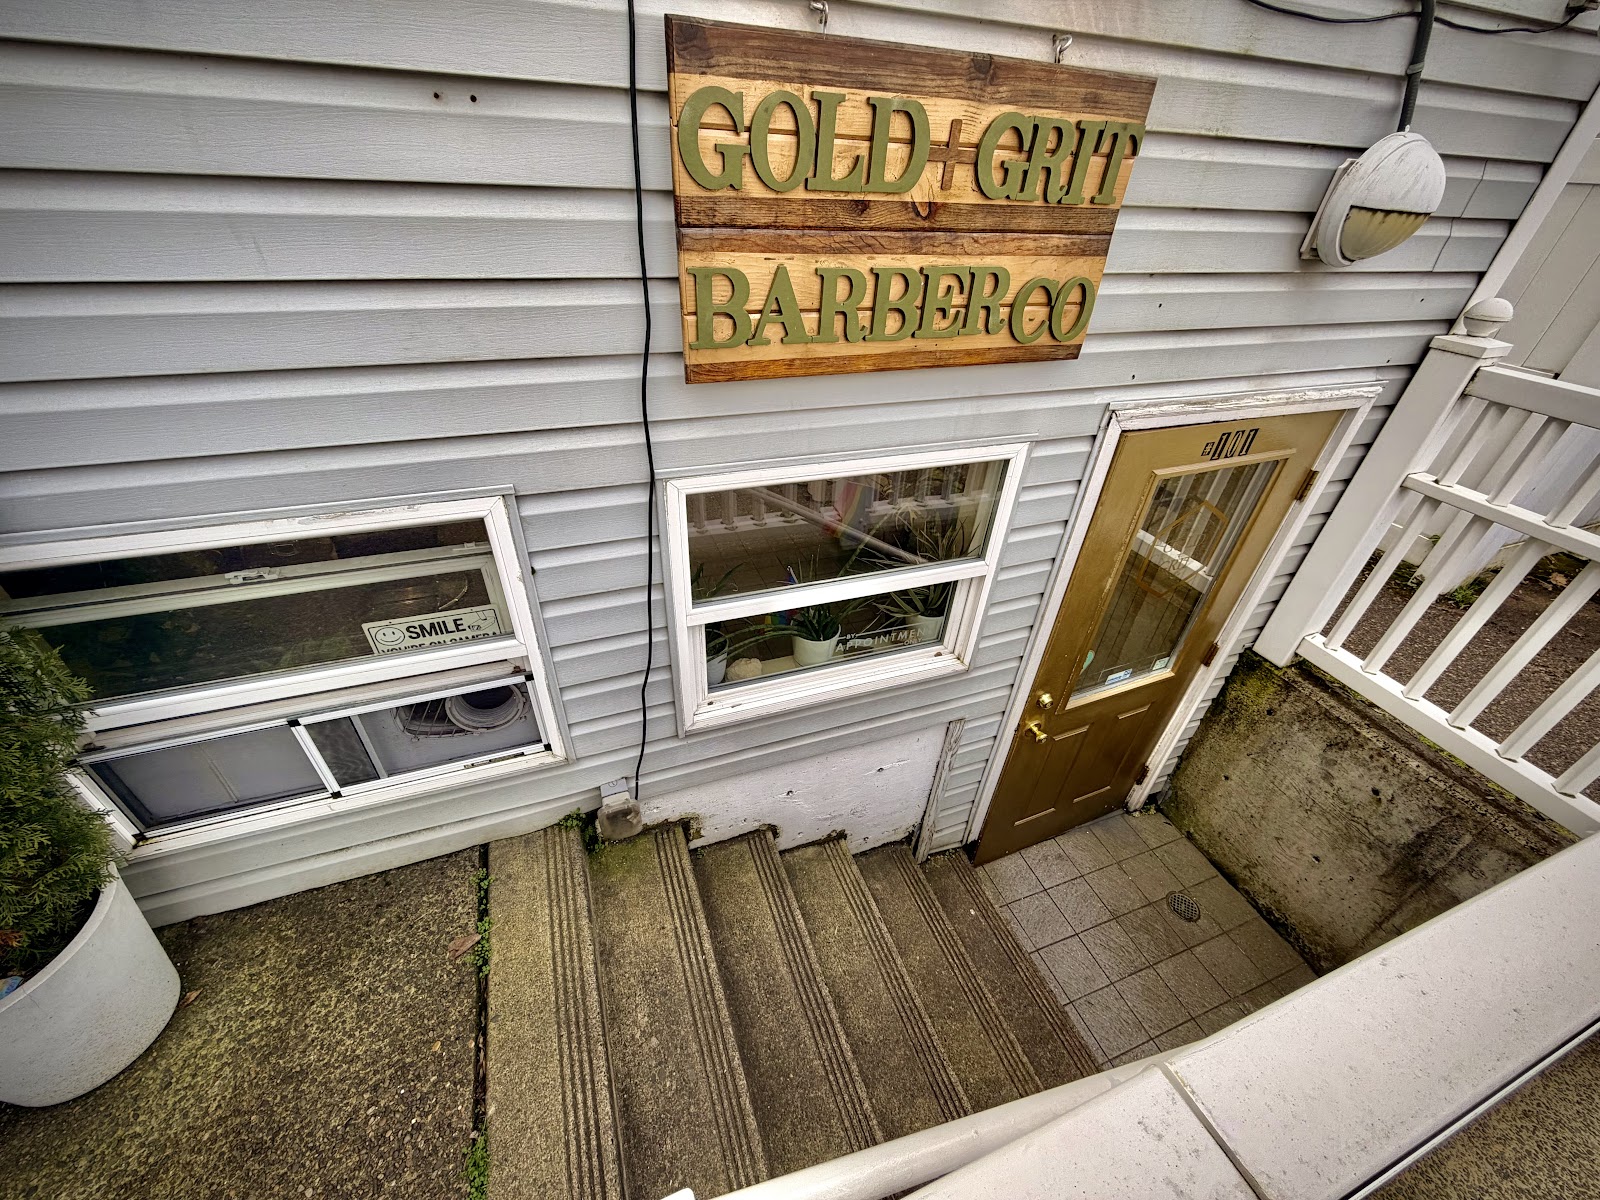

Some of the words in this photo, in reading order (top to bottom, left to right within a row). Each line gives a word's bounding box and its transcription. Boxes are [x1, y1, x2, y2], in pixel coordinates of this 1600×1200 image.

[678, 85, 931, 193] GOLD
[977, 111, 1147, 205] GRIT
[686, 264, 1010, 350] BARBER
[1010, 276, 1096, 345] CO
[1201, 427, 1260, 461] #101
[405, 617, 467, 640] SMILE
[835, 627, 929, 653] APPOINTMEN
[846, 632, 857, 640] BY
